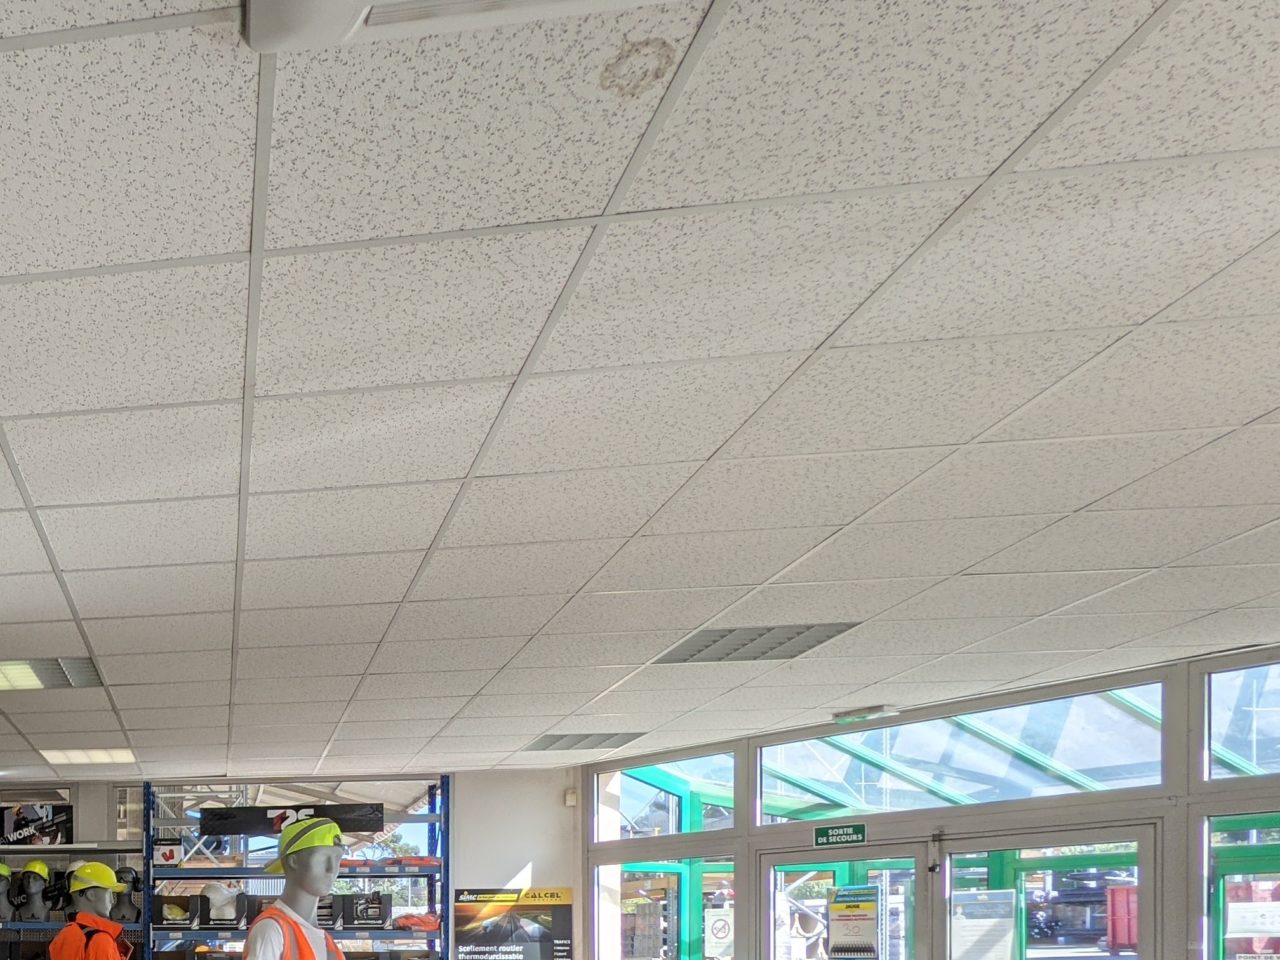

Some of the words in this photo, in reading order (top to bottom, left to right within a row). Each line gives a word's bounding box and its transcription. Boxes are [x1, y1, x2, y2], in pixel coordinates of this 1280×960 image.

[8, 825, 37, 843] WORK
[828, 827, 853, 836] SORTIE
[829, 834, 863, 843] SECOURS
